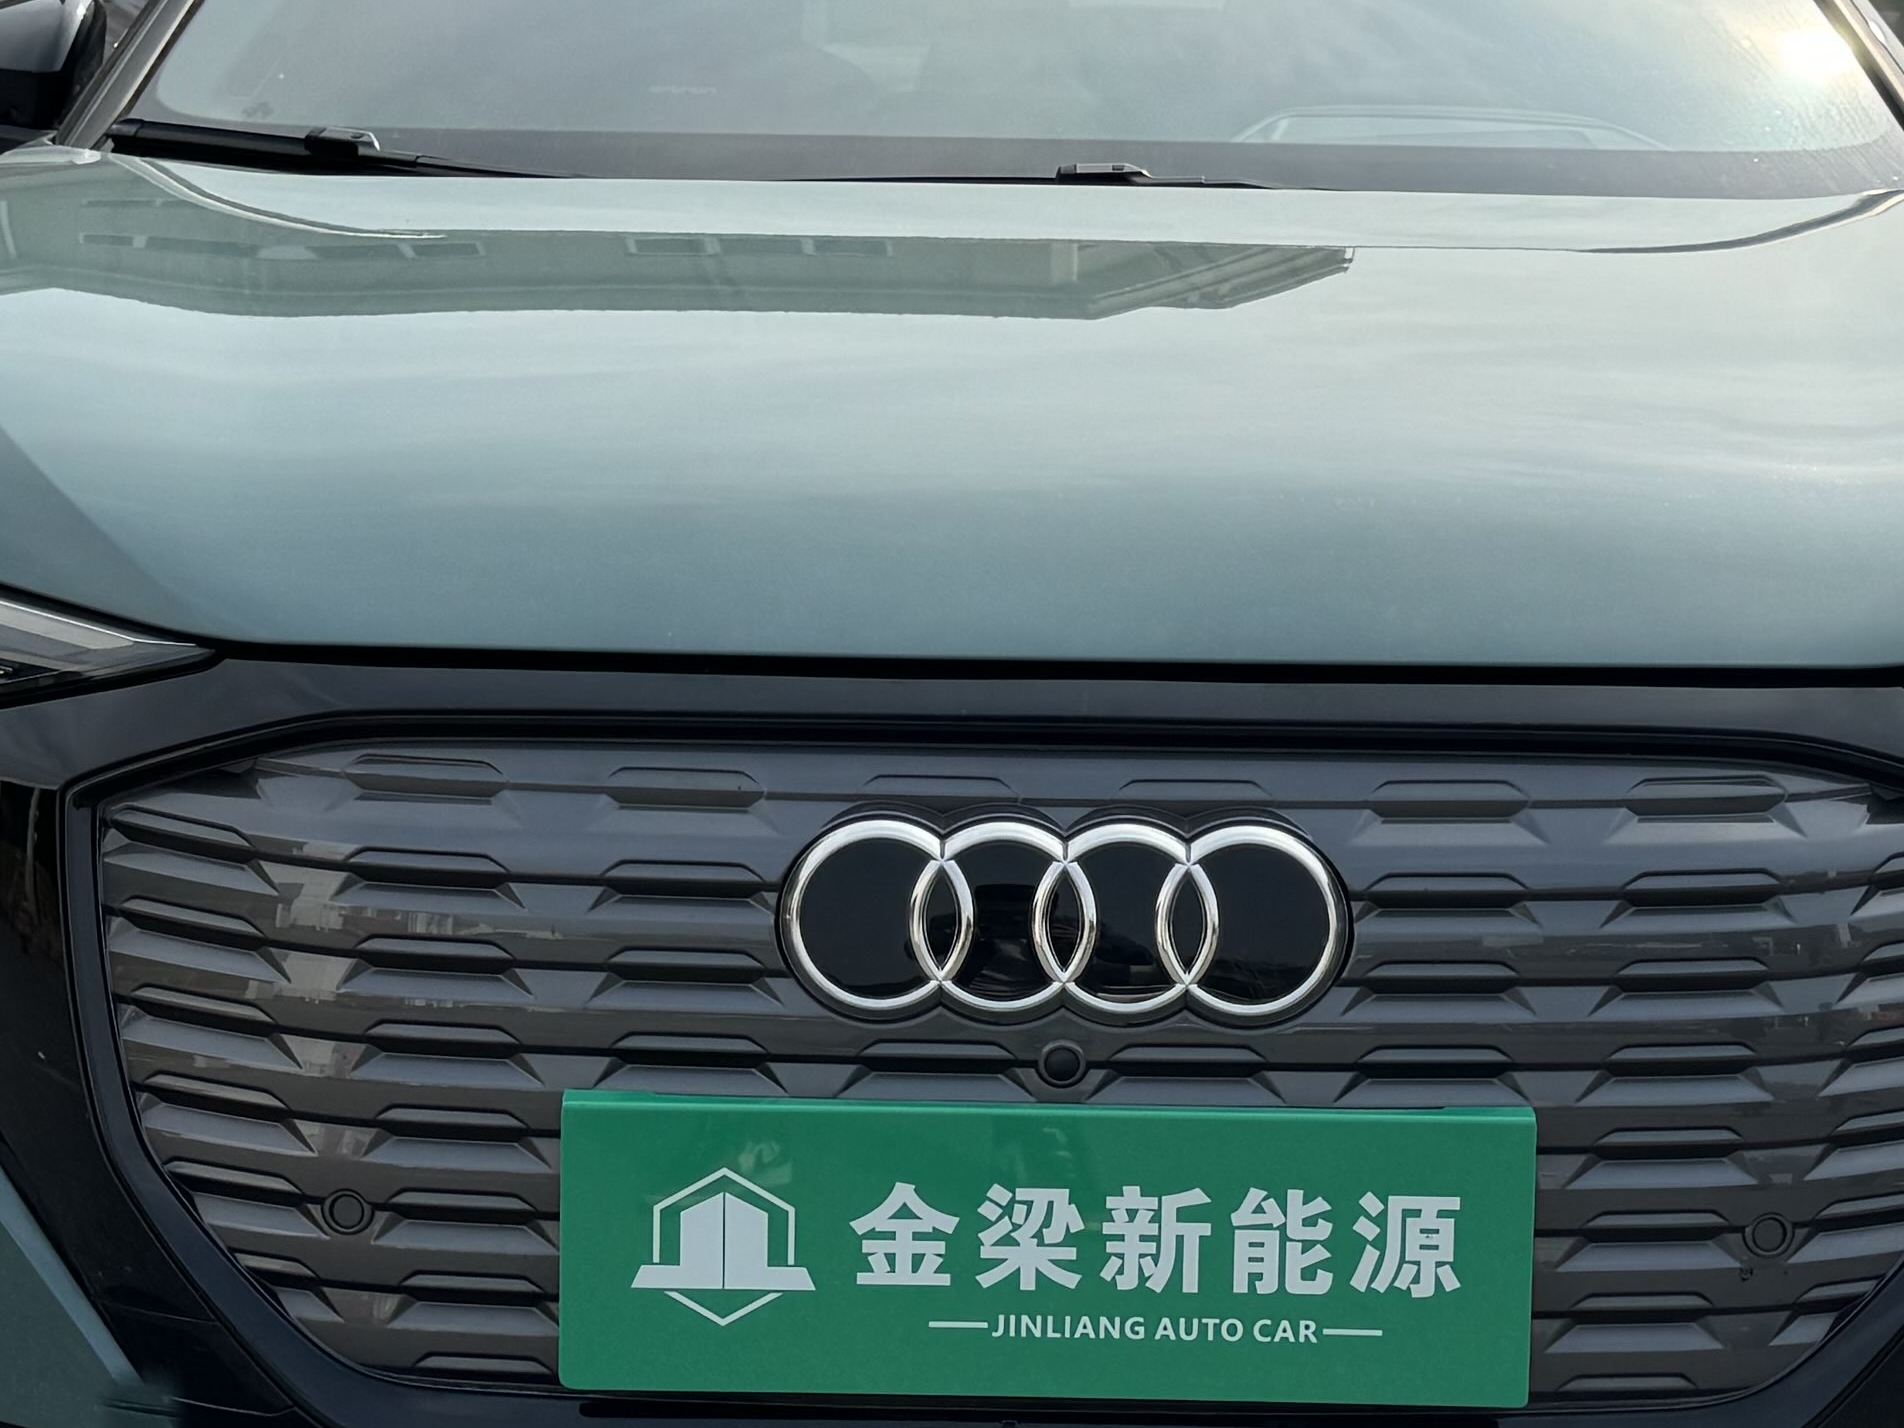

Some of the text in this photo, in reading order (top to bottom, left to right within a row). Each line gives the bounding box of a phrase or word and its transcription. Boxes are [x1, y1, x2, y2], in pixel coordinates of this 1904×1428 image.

[848, 1180, 1462, 1299] 金梁新能源
[991, 1313, 1319, 1344] JINLIANG AUTO CAR
